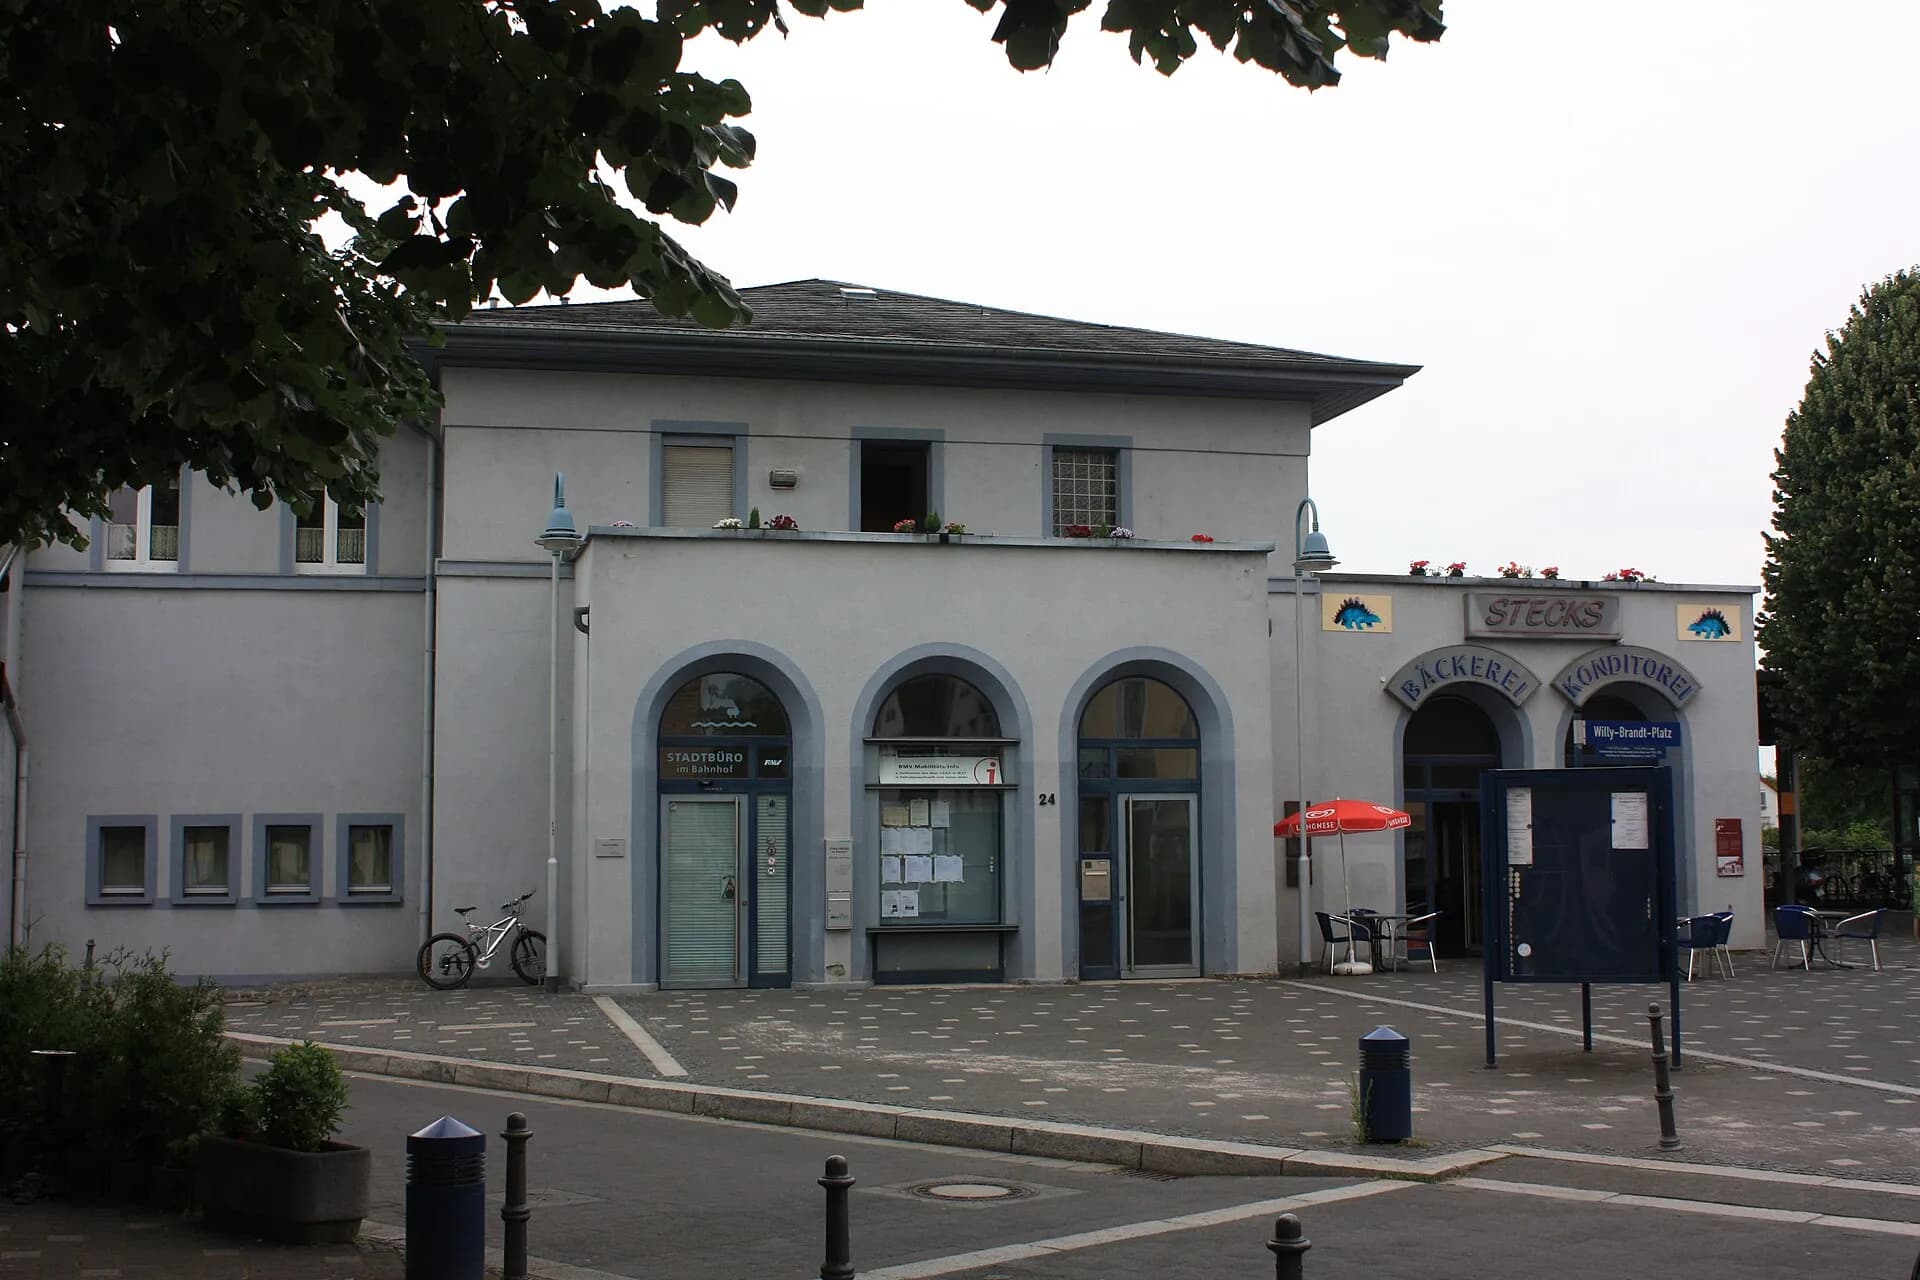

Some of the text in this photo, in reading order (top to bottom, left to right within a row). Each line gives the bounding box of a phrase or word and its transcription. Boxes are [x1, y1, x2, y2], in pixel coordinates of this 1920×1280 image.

[1484, 598, 1605, 629] STECKS
[1400, 654, 1530, 702] BÄCKEREI
[1561, 653, 1693, 701] KONDITOREI
[1593, 725, 1673, 741] Willy-Brandt-Platz
[666, 751, 743, 763] STADTBÜRO
[676, 764, 734, 773] im Bahnhof
[1038, 793, 1056, 806] 24
